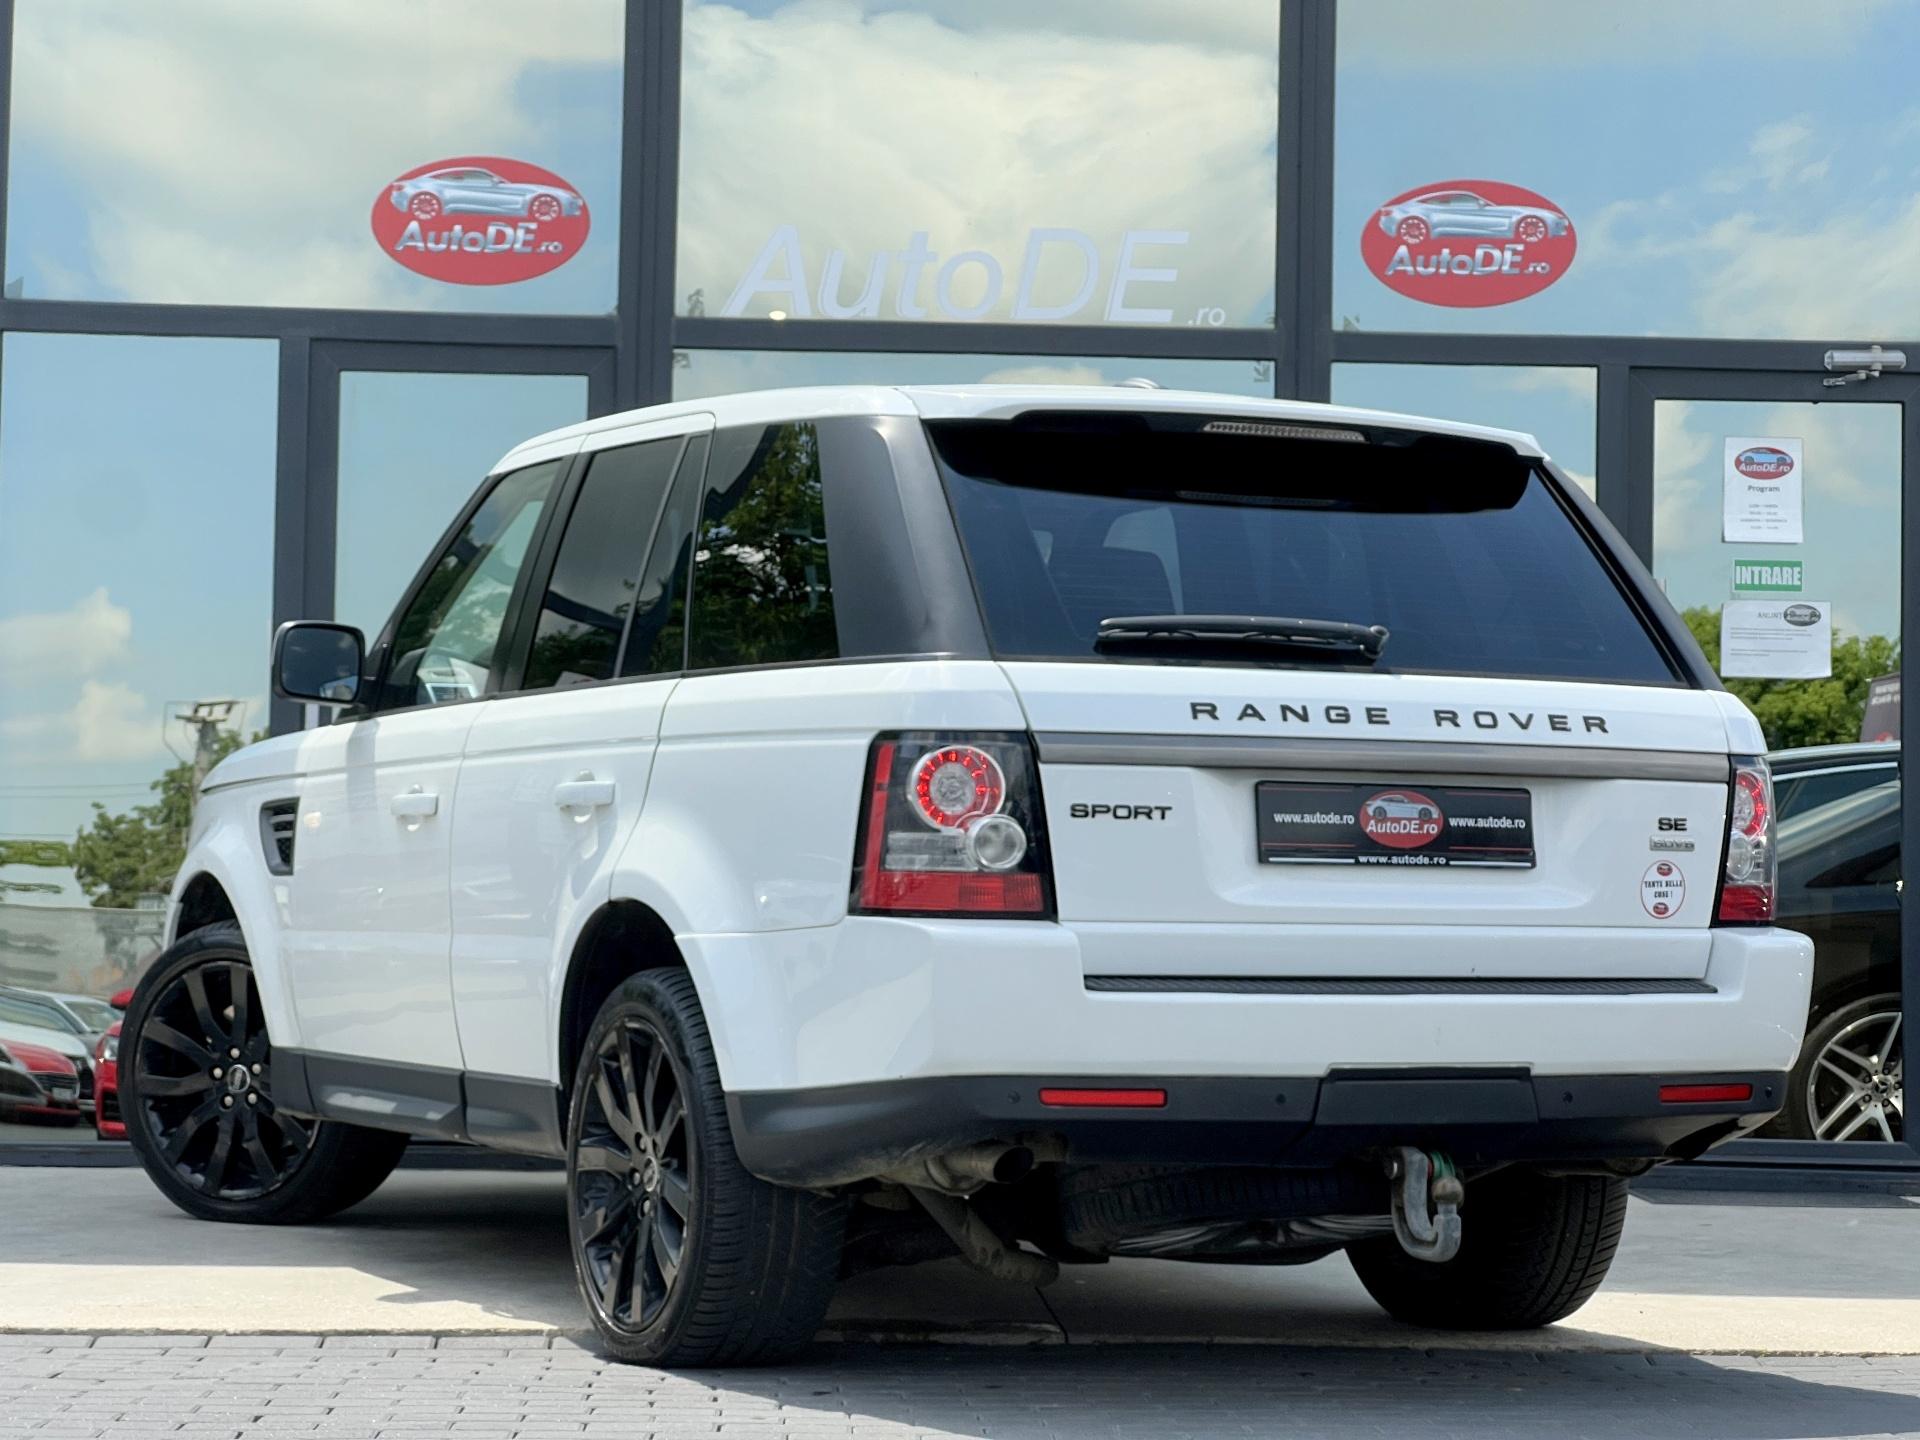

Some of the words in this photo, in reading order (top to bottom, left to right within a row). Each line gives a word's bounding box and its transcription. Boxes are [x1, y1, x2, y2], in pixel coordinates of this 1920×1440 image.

[1747, 485, 1781, 493] Program
[1735, 565, 1802, 585] INTRARE
[1190, 702, 1390, 725] RANGE
[1433, 709, 1609, 733] ROVER
[1070, 803, 1173, 820] SPORT
[1273, 811, 1355, 824] www.autode.ro
[1366, 819, 1438, 834] AutoDE.ro
[1448, 816, 1526, 829] www.autode.ro
[1658, 817, 1687, 831] SE
[1358, 855, 1446, 865] www.autode.ro
